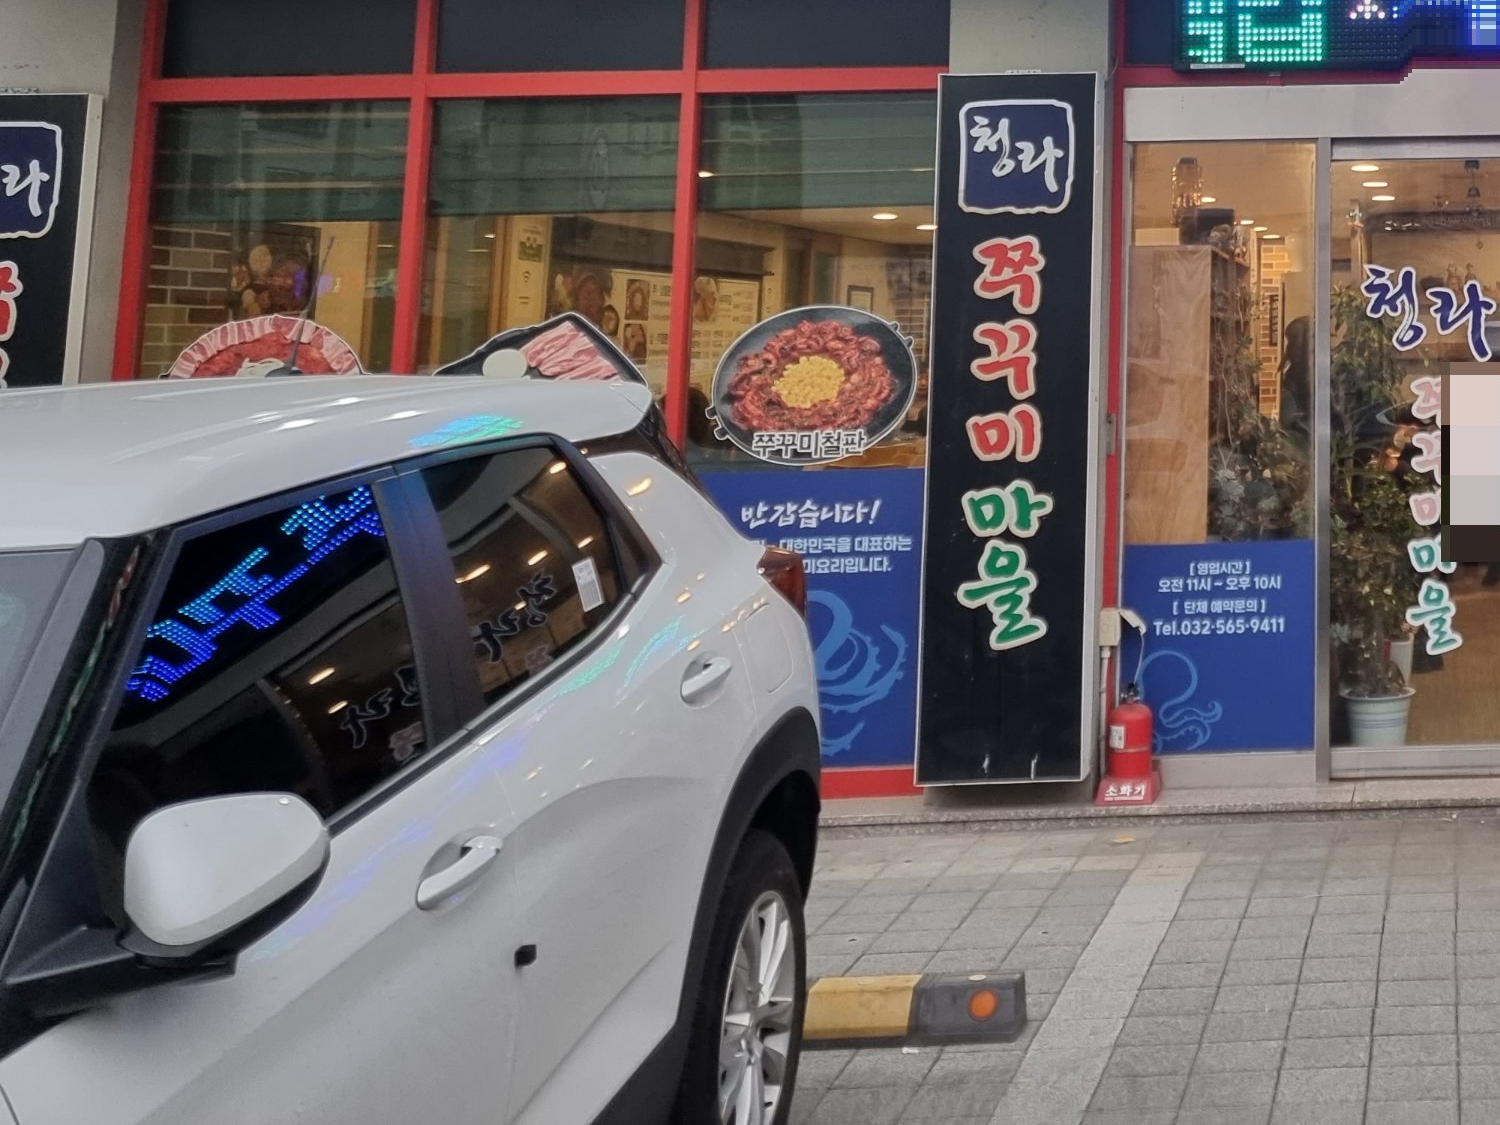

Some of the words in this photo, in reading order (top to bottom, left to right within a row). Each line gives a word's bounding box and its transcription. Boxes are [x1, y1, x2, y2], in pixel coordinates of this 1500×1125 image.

[969, 118, 1064, 192] 청라
[1361, 262, 1496, 362] 청라
[752, 429, 867, 458] 쭈꾸미철판
[741, 499, 882, 530] 반갑습니다!
[779, 537, 852, 554] 대한민국을
[854, 535, 912, 553] 대표하는
[803, 556, 893, 574] 미요리입니다.
[1197, 561, 1244, 576] 영업시간
[1158, 578, 1184, 593] 오전
[1186, 577, 1212, 592] 11시
[1225, 576, 1251, 591] 오후
[1253, 575, 1282, 590] 10시
[1184, 600, 1208, 615] 단체
[1210, 599, 1258, 614] 예약문의
[1104, 783, 1146, 797] 소화기
